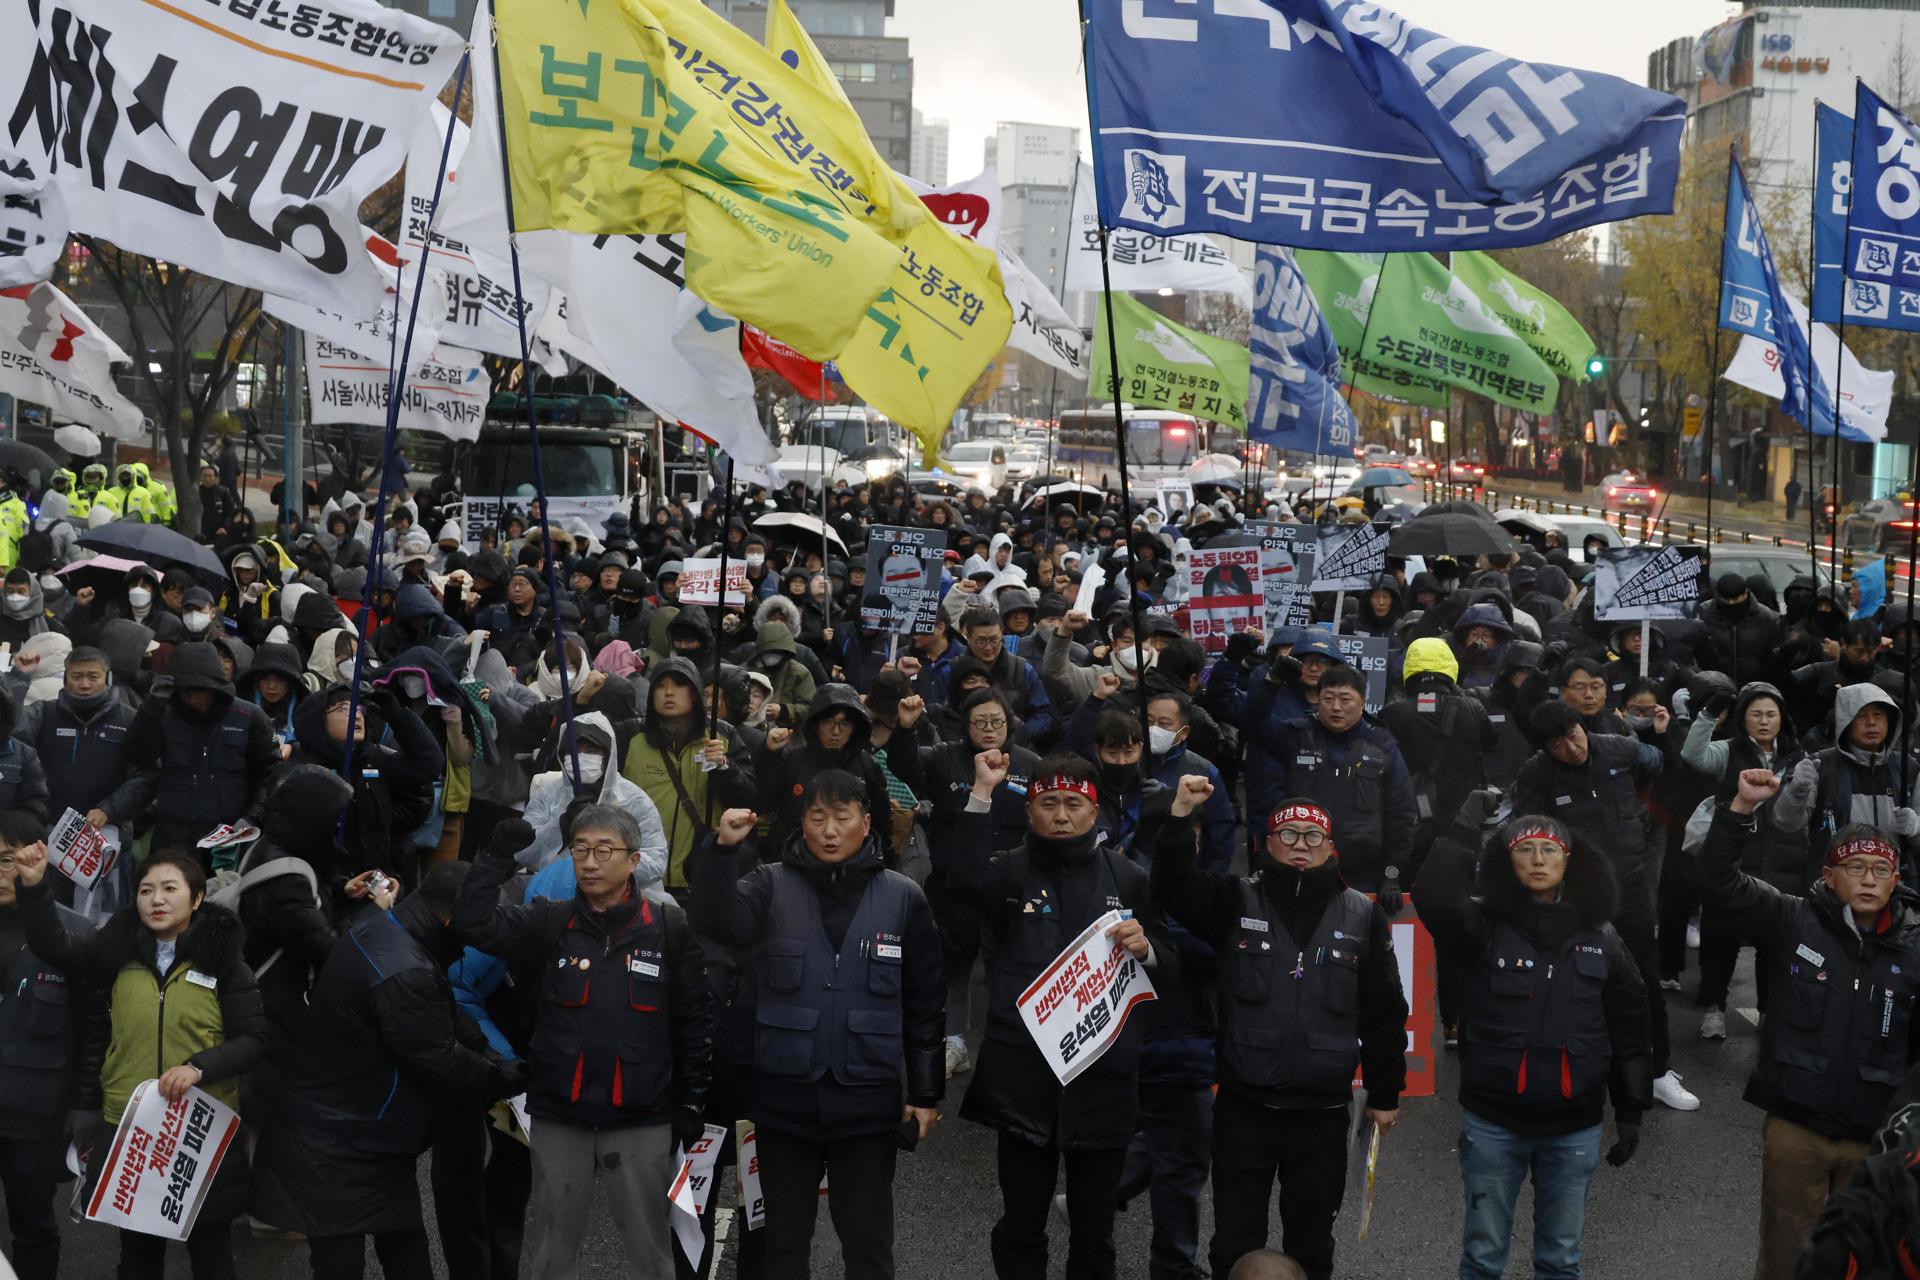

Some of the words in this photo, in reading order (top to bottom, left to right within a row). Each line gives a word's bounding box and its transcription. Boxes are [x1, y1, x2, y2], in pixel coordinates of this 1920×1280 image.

[1201, 146, 1653, 238] 전국금속노동조합
[719, 196, 787, 244] Workers'
[787, 232, 834, 268] Union
[900, 245, 984, 327] 노동조합
[1418, 326, 1510, 369] 전국건설노동조합
[1136, 364, 1220, 392] 전국건설노동조합
[1376, 335, 1546, 404] 수도권북부지역본부
[871, 529, 897, 542] 노동
[900, 531, 925, 545] 혐오
[892, 545, 917, 558] 인권
[920, 547, 945, 560] 혐오
[1293, 542, 1317, 554] 혐오
[1190, 552, 1217, 568] 노동
[880, 586, 940, 600] 대한민국에서
[1658, 578, 1700, 601] 퇴진하라!
[915, 623, 934, 633] 없다
[1361, 656, 1386, 671] 혐오
[1034, 950, 1091, 1026] 반헌법적
[1059, 997, 1111, 1065] 윤석열
[1108, 958, 1136, 1012] 파면!
[112, 1125, 153, 1216] 반헌법적
[160, 1150, 198, 1225] 윤석열
[182, 1096, 216, 1155] 파면!
